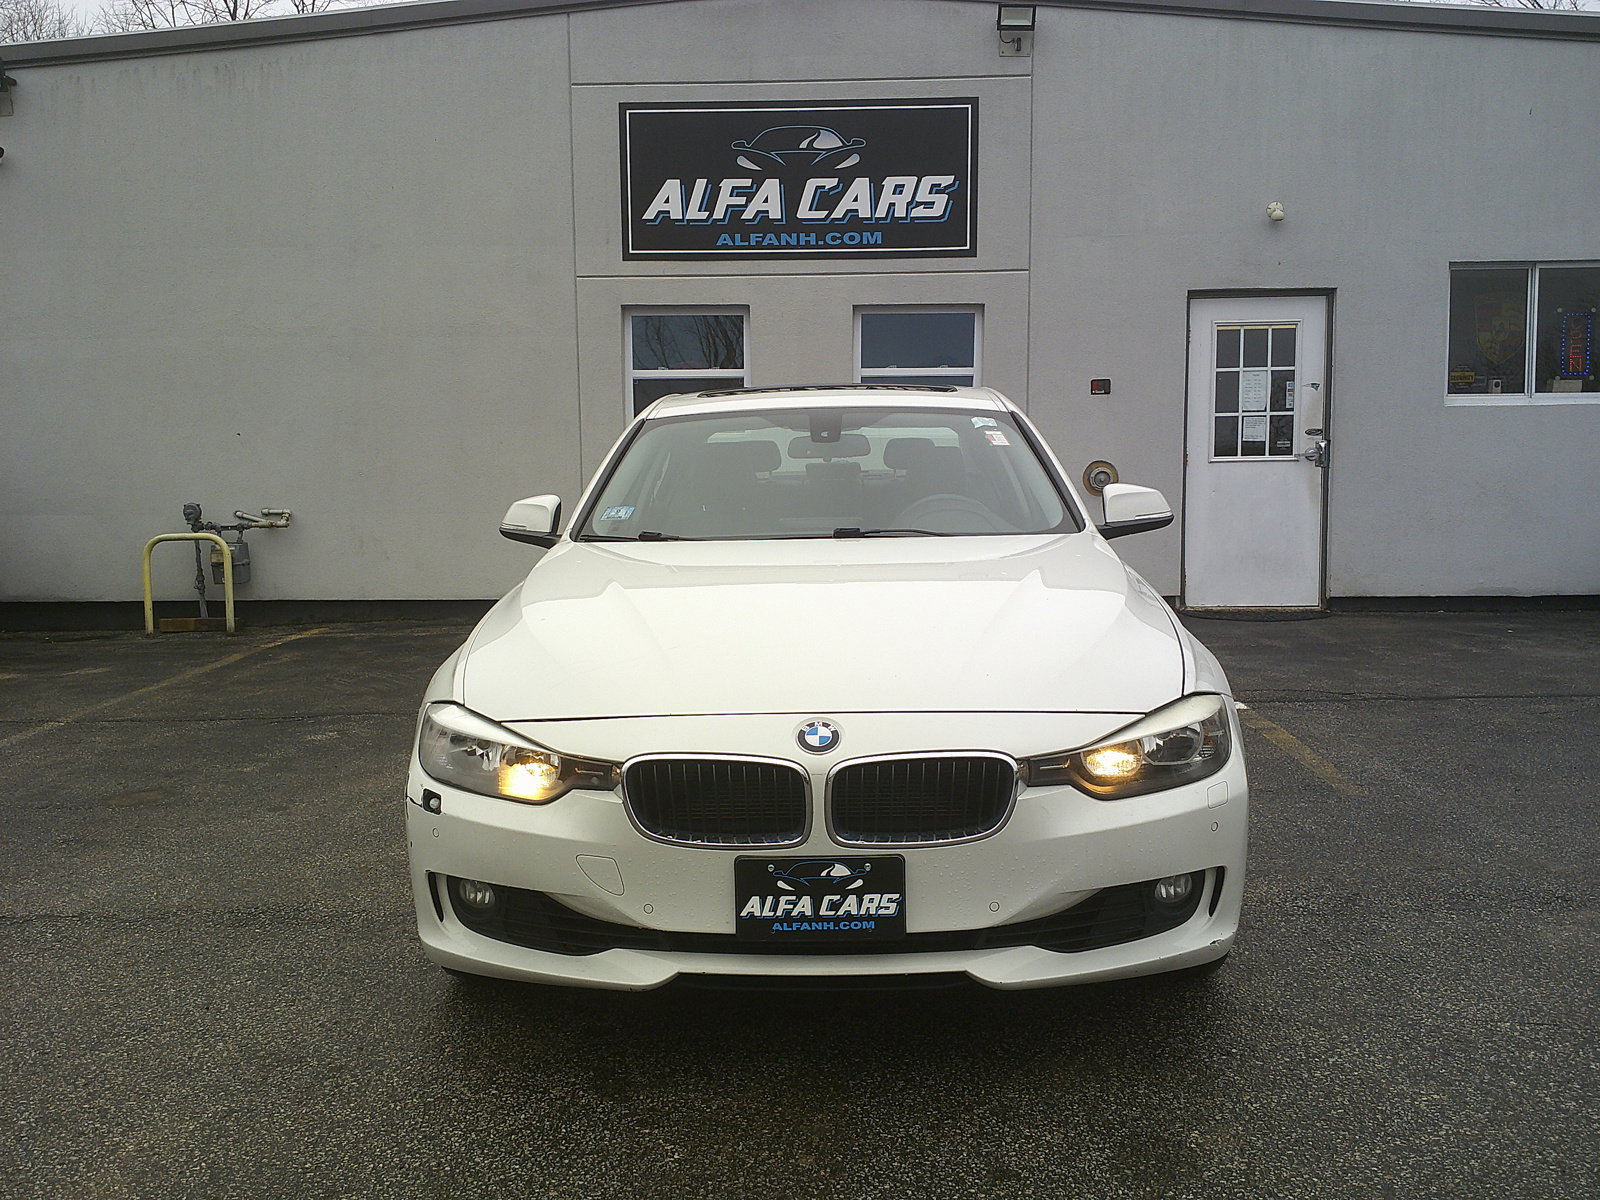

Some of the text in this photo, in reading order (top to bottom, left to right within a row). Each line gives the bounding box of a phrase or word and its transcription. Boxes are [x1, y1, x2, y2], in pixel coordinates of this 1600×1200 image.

[642, 175, 959, 225] ALFA CARS
[716, 231, 883, 246] ALFANH.COM
[740, 893, 903, 919] ALFA CARS
[772, 920, 875, 931] ALFANH.COM
